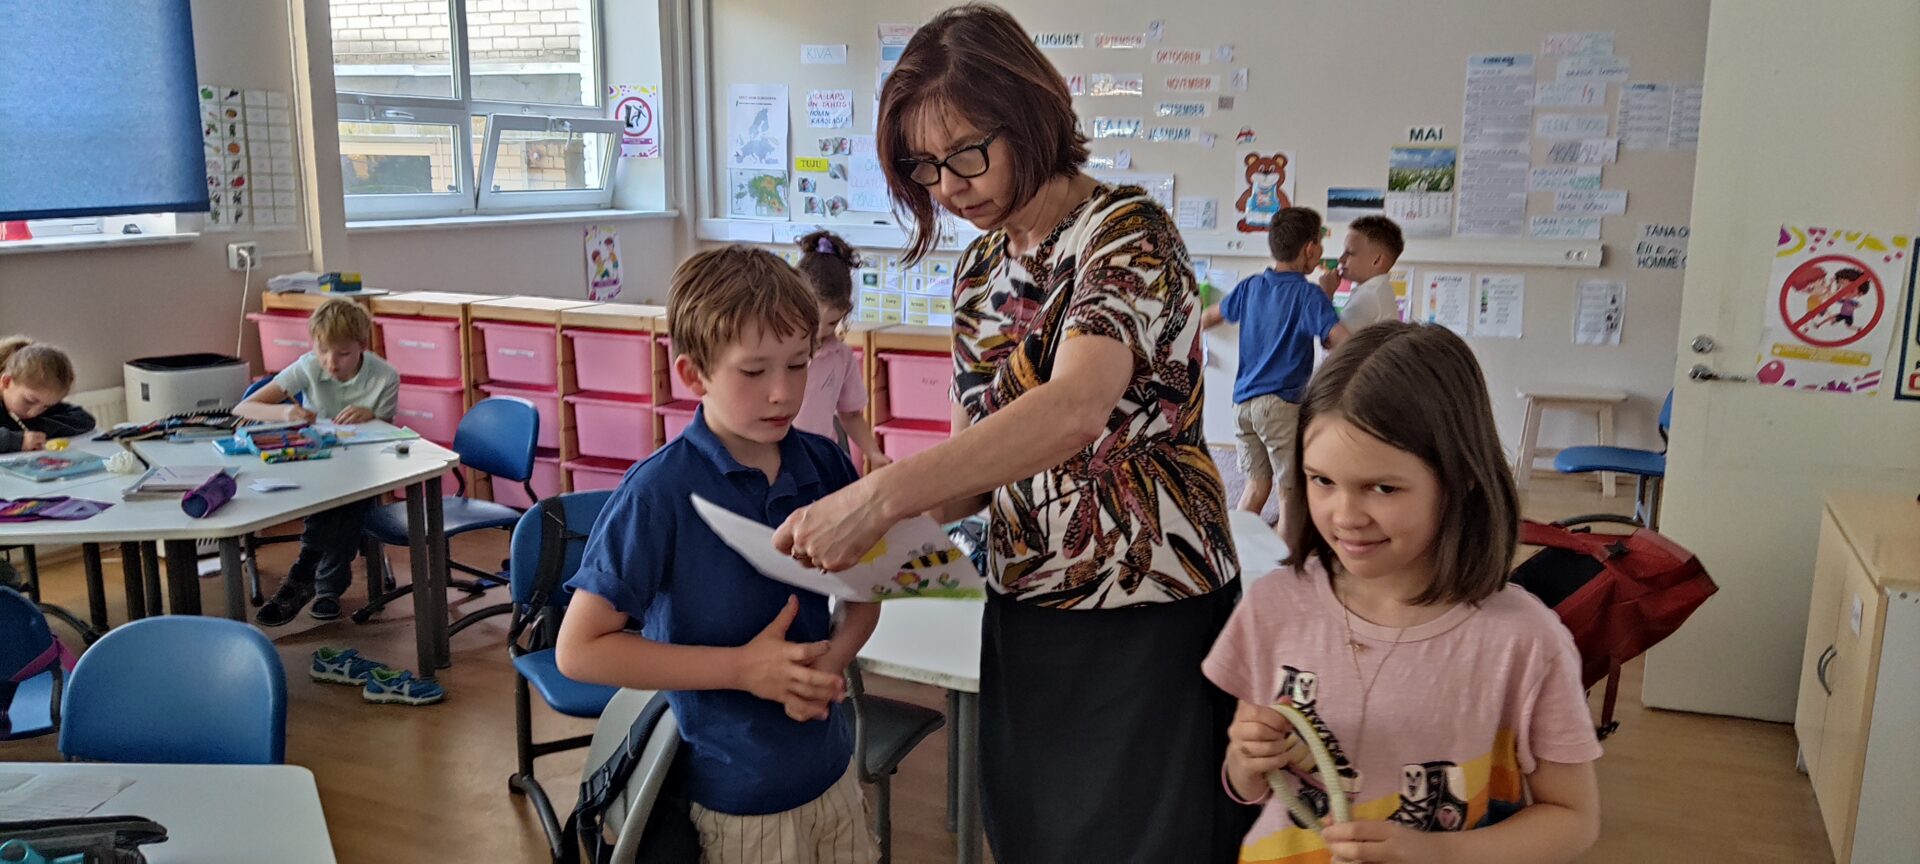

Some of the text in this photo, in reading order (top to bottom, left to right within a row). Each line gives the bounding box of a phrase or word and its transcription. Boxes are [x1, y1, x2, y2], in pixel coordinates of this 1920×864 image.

[1033, 33, 1080, 46] AUGUST
[806, 46, 833, 60] KIVA
[1156, 49, 1201, 64] OKTOOBER
[1166, 77, 1211, 90] NOVEMBER
[1093, 118, 1140, 138] TALV
[1409, 127, 1443, 142] MAI
[800, 160, 822, 169] TUJU
[1637, 256, 1680, 270] HOMME
